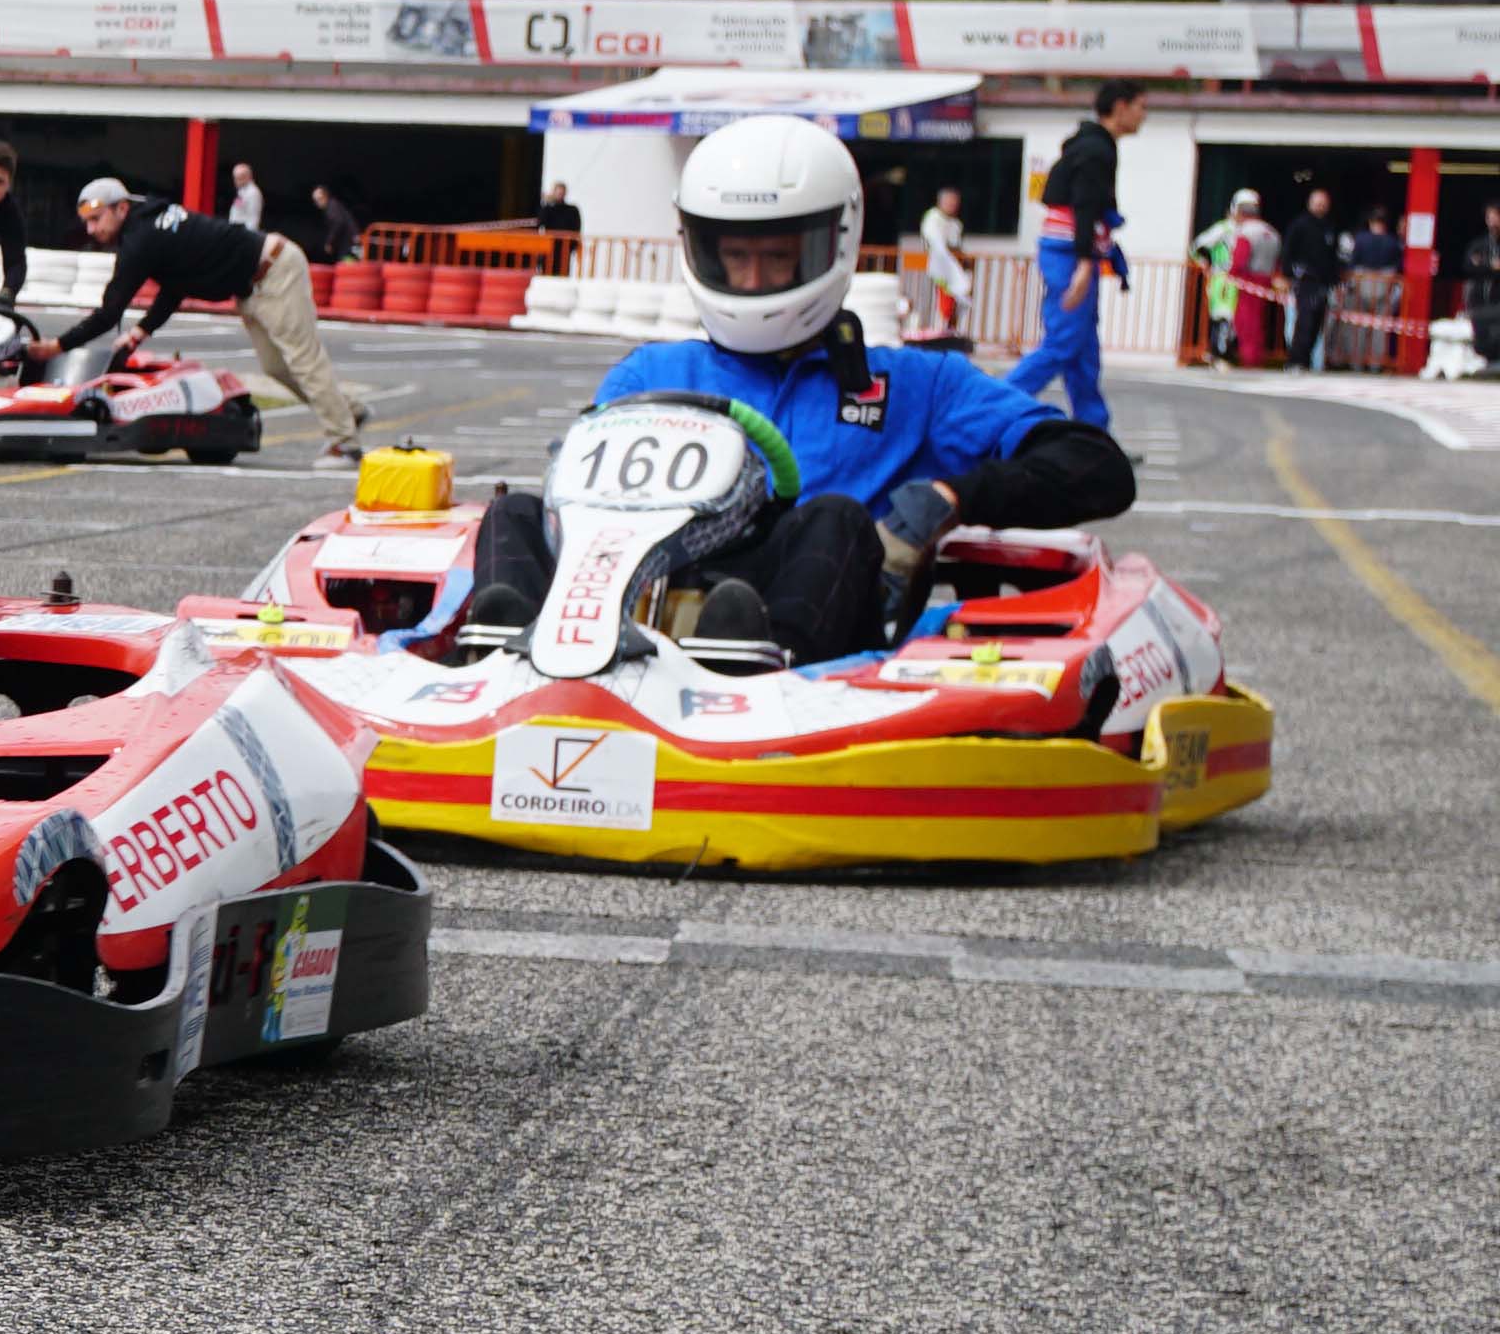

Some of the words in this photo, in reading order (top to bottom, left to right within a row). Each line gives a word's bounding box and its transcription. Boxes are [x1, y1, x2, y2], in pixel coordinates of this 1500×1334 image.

[579, 436, 709, 492] 160
[500, 793, 606, 816] CORDEIRO
[102, 769, 258, 927] ERBERTO
